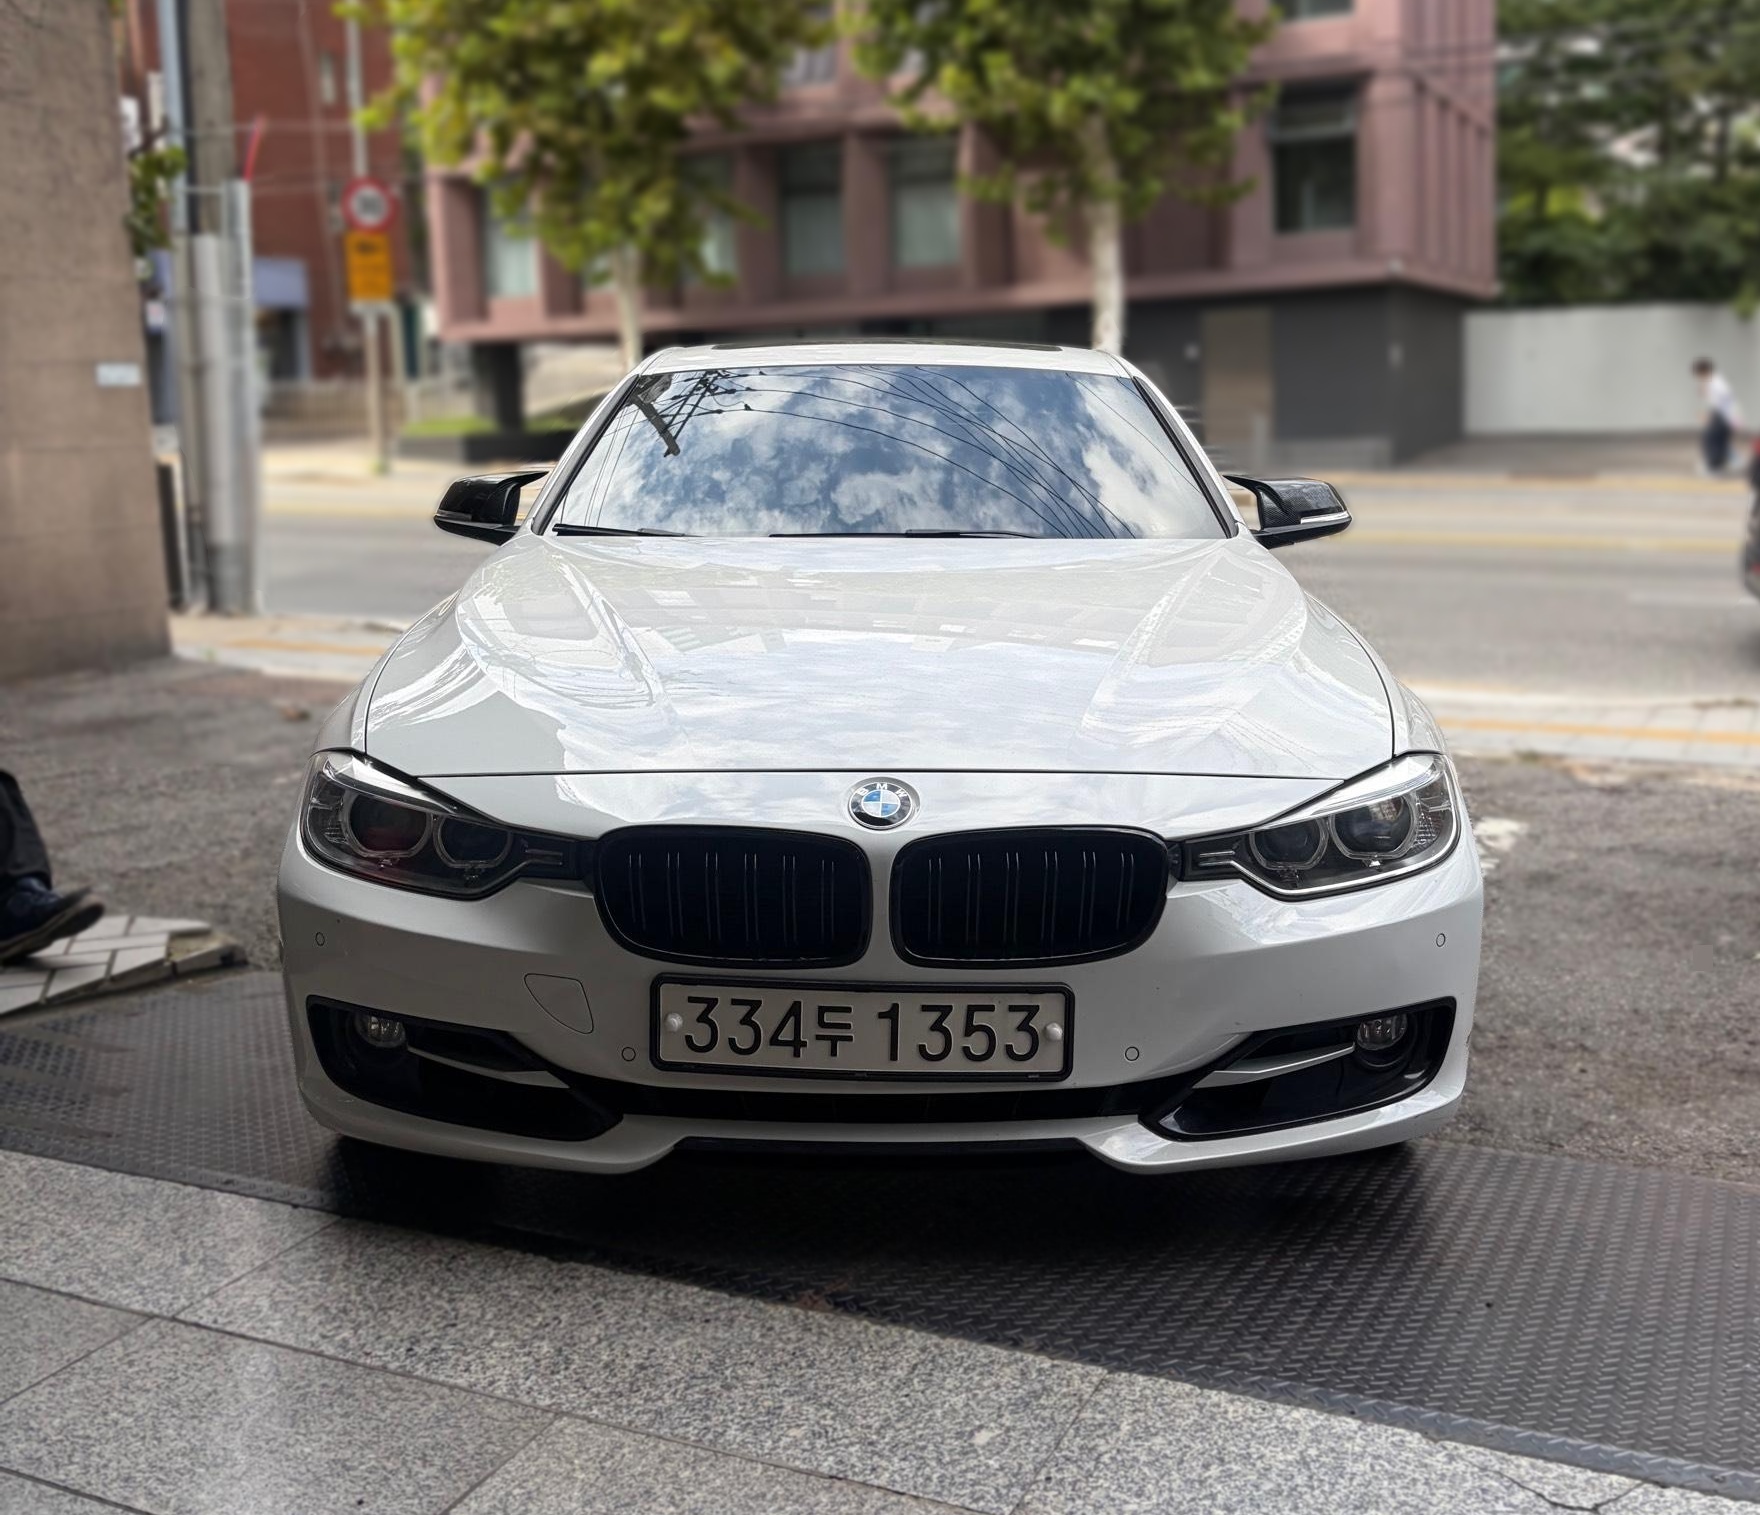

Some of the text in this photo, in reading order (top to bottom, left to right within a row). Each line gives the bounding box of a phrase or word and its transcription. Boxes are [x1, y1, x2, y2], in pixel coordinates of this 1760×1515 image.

[855, 782, 908, 798] BMW
[684, 996, 1041, 1063] 334두 1353
